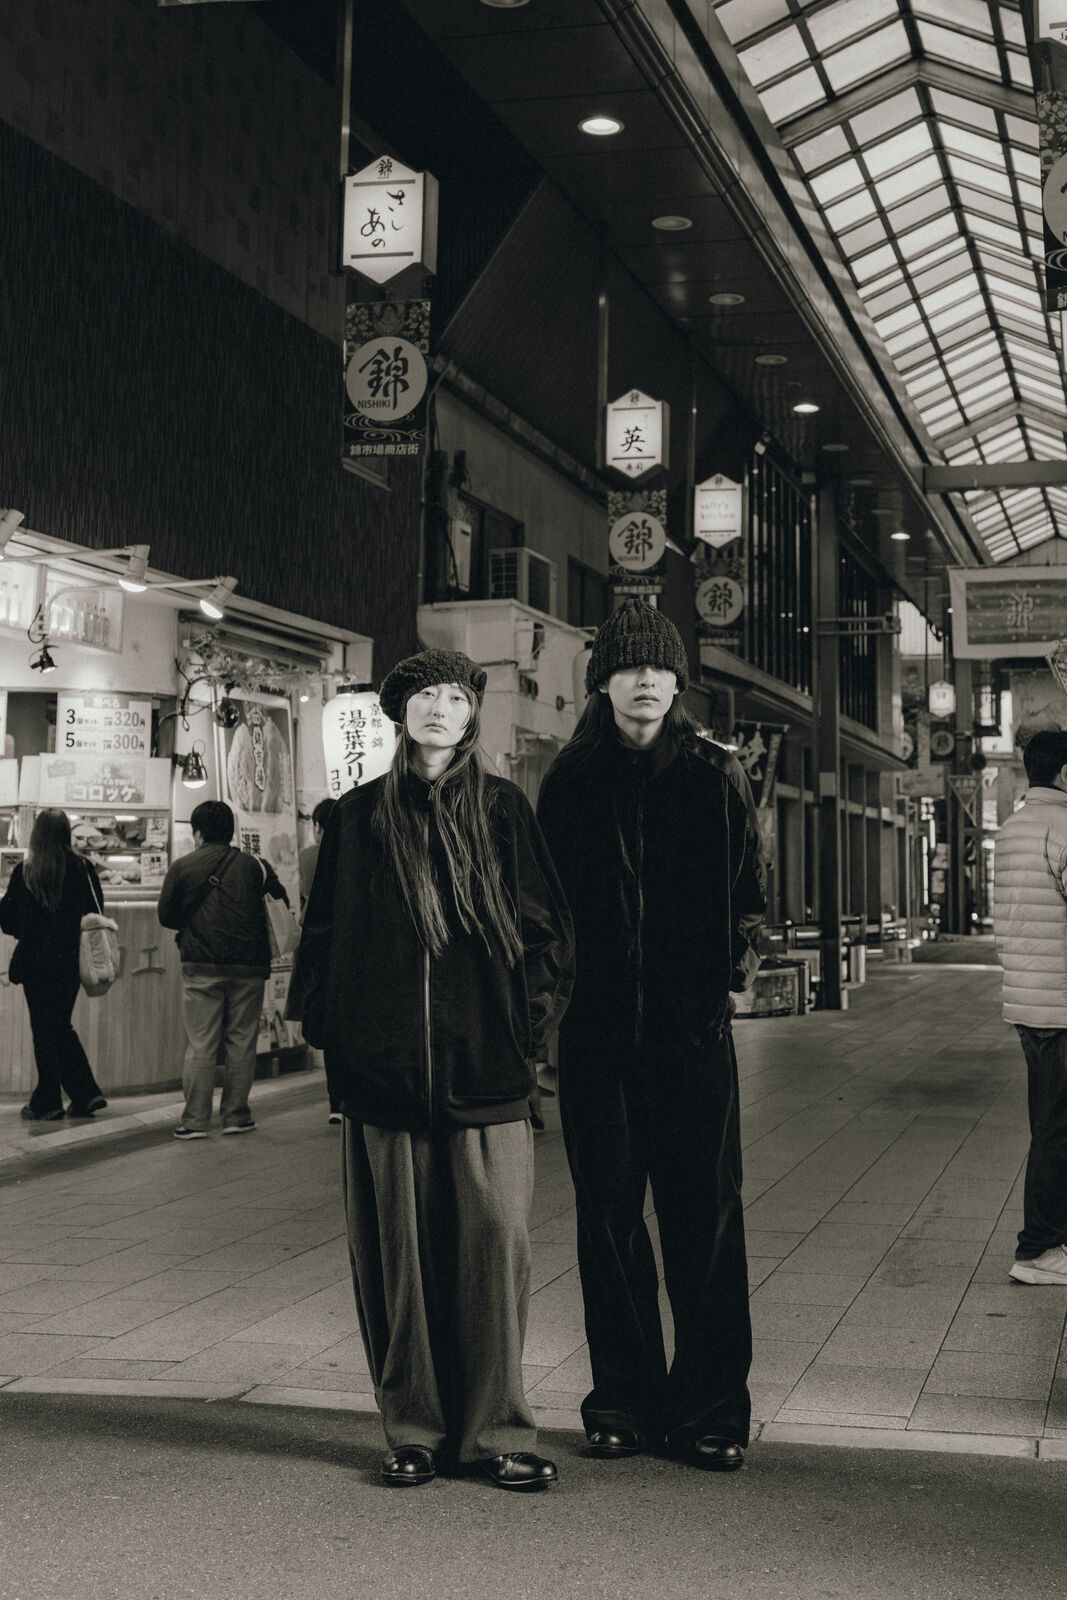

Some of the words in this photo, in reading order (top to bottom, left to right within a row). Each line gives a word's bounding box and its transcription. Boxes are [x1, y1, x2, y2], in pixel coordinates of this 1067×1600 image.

[376, 159, 392, 178] 錦
[358, 347, 410, 411] 錦
[358, 400, 390, 409] NISHIKI
[350, 443, 419, 456] 錦市場商店街
[621, 426, 646, 452] 英
[618, 519, 653, 562] 錦
[703, 582, 733, 619] 錦
[73, 785, 136, 802] コロッケ
